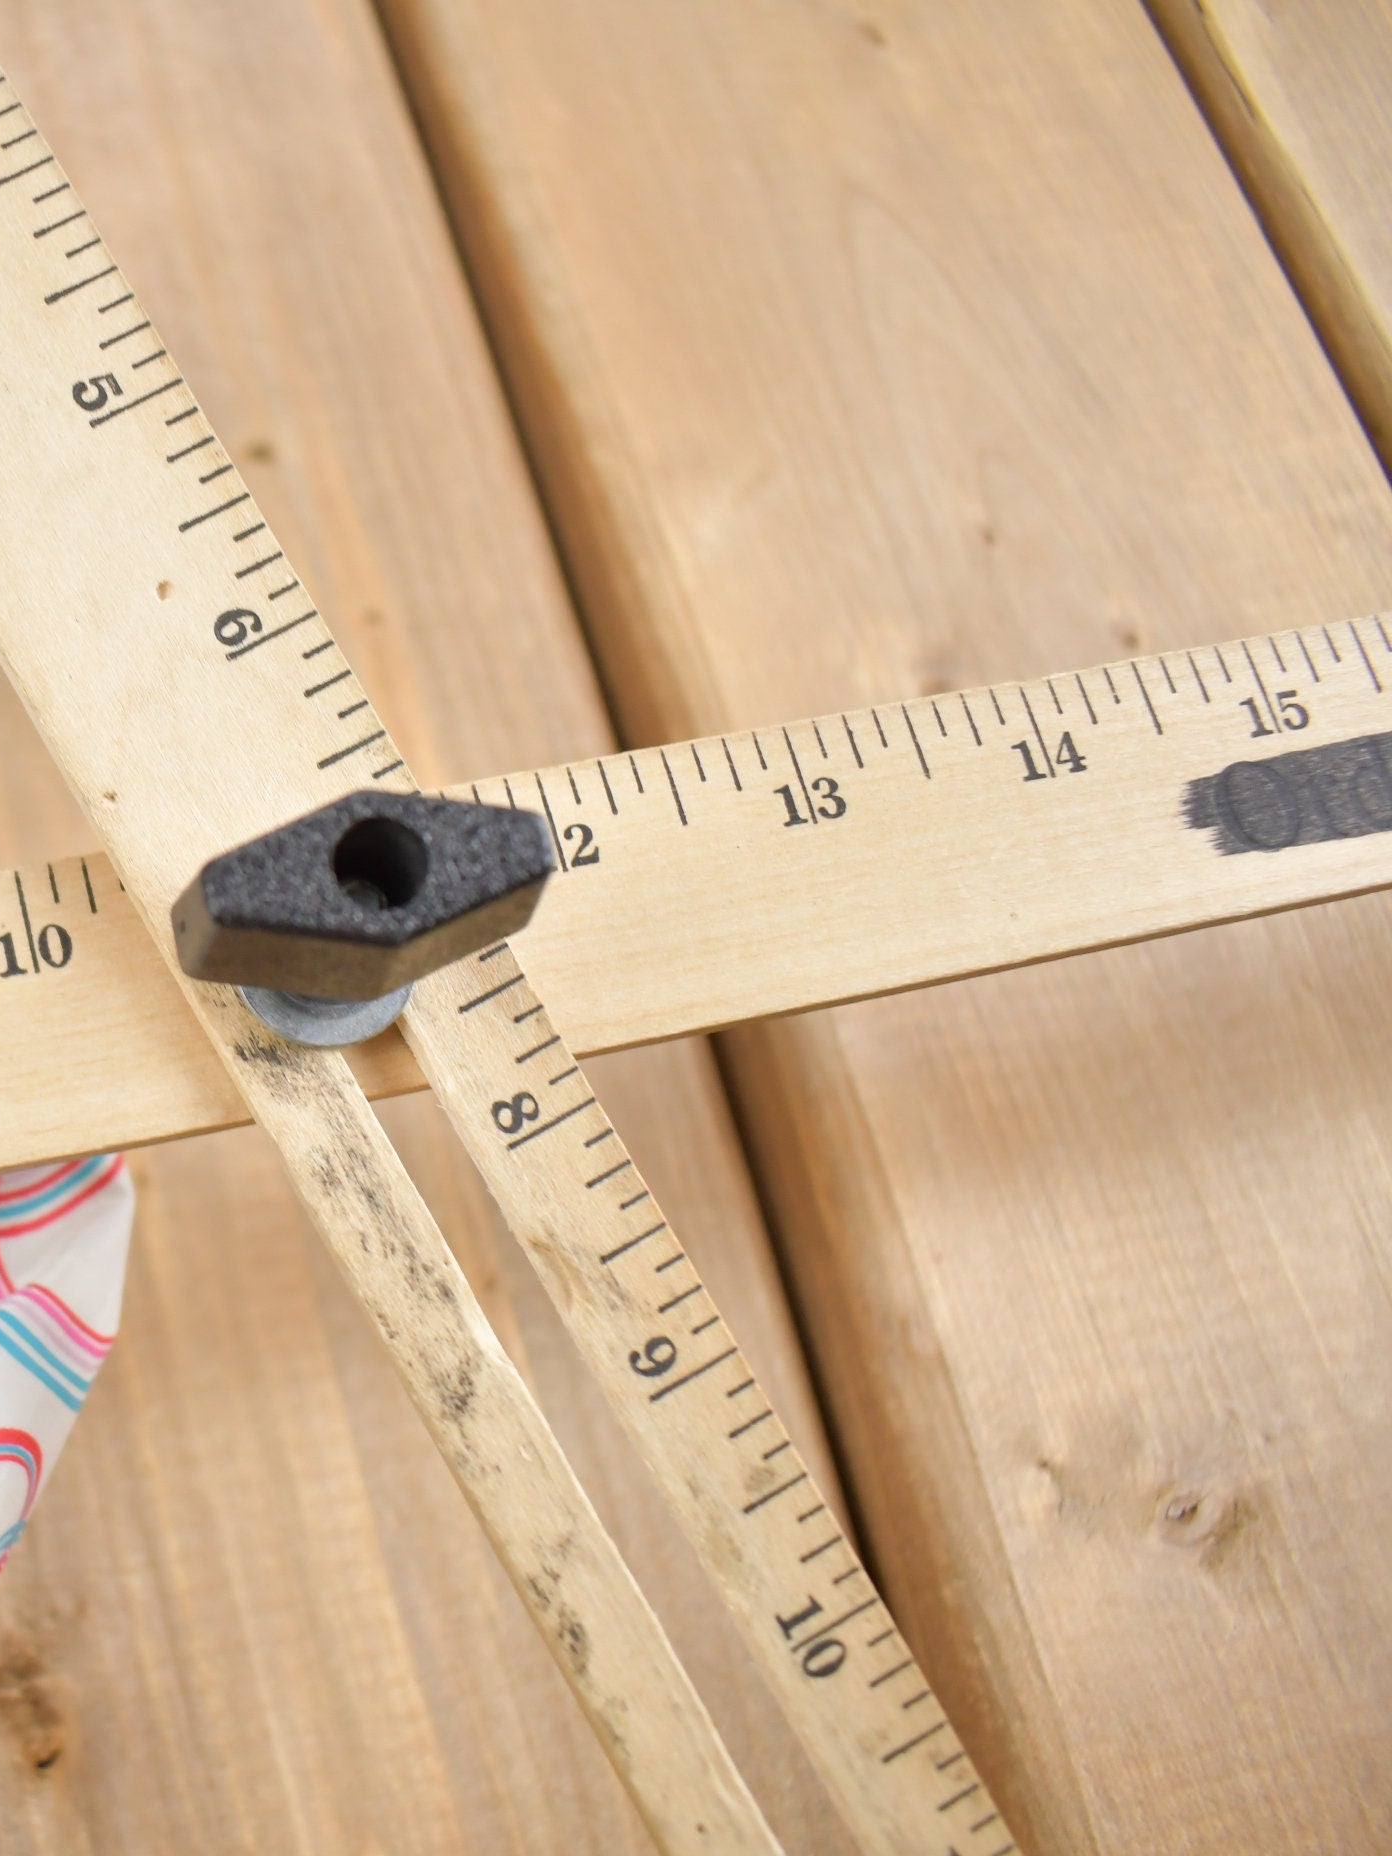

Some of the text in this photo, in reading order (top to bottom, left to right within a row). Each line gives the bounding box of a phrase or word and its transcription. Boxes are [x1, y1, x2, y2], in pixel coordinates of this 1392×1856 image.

[71, 372, 123, 412] 5
[213, 608, 263, 647] 6
[490, 1091, 540, 1136] 8
[629, 1335, 678, 1377] 9
[775, 1594, 847, 1680] 10
[546, 823, 600, 869] 2
[773, 776, 849, 827] 13
[1010, 731, 1087, 782] 14
[1238, 690, 1311, 738] 15
